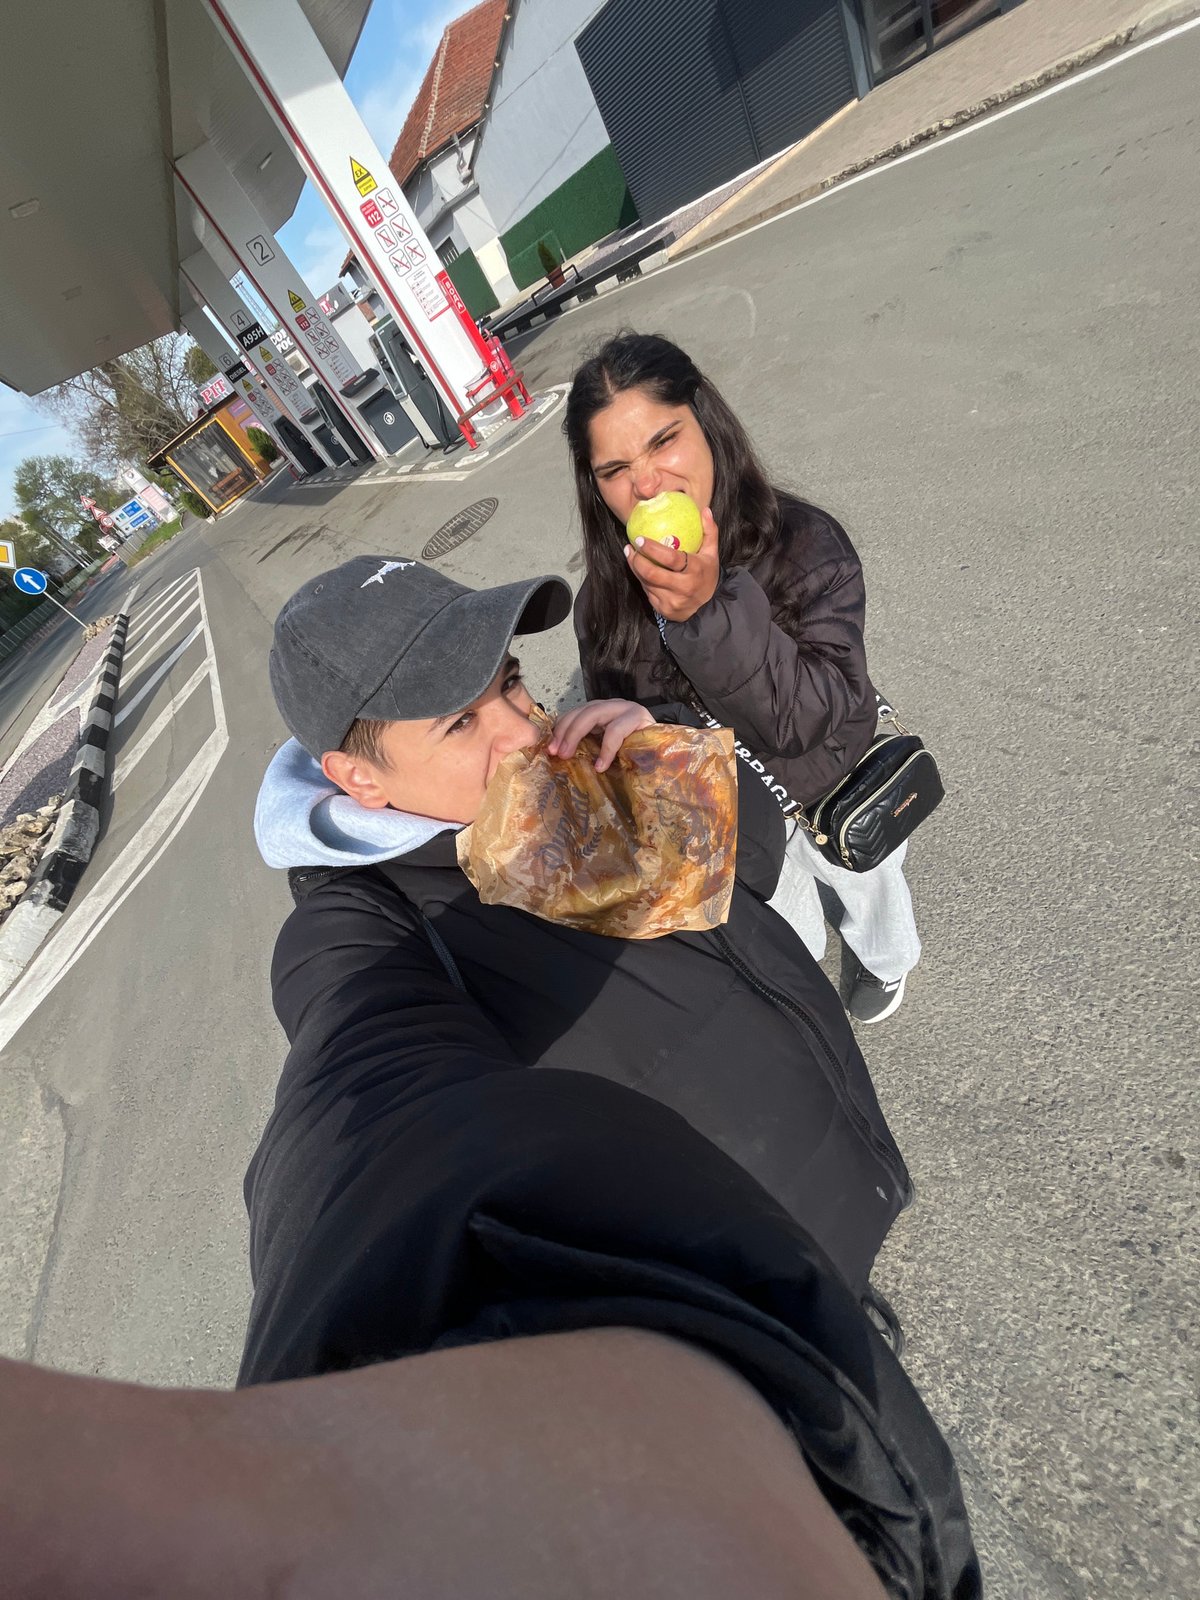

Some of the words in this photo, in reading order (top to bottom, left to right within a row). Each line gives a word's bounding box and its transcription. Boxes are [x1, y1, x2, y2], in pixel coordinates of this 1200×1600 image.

[355, 169, 364, 178] EX
[367, 210, 382, 225] 112
[253, 241, 269, 261] 2
[237, 315, 245, 327] 4
[224, 355, 232, 366] 6
[200, 378, 227, 404] PIT
